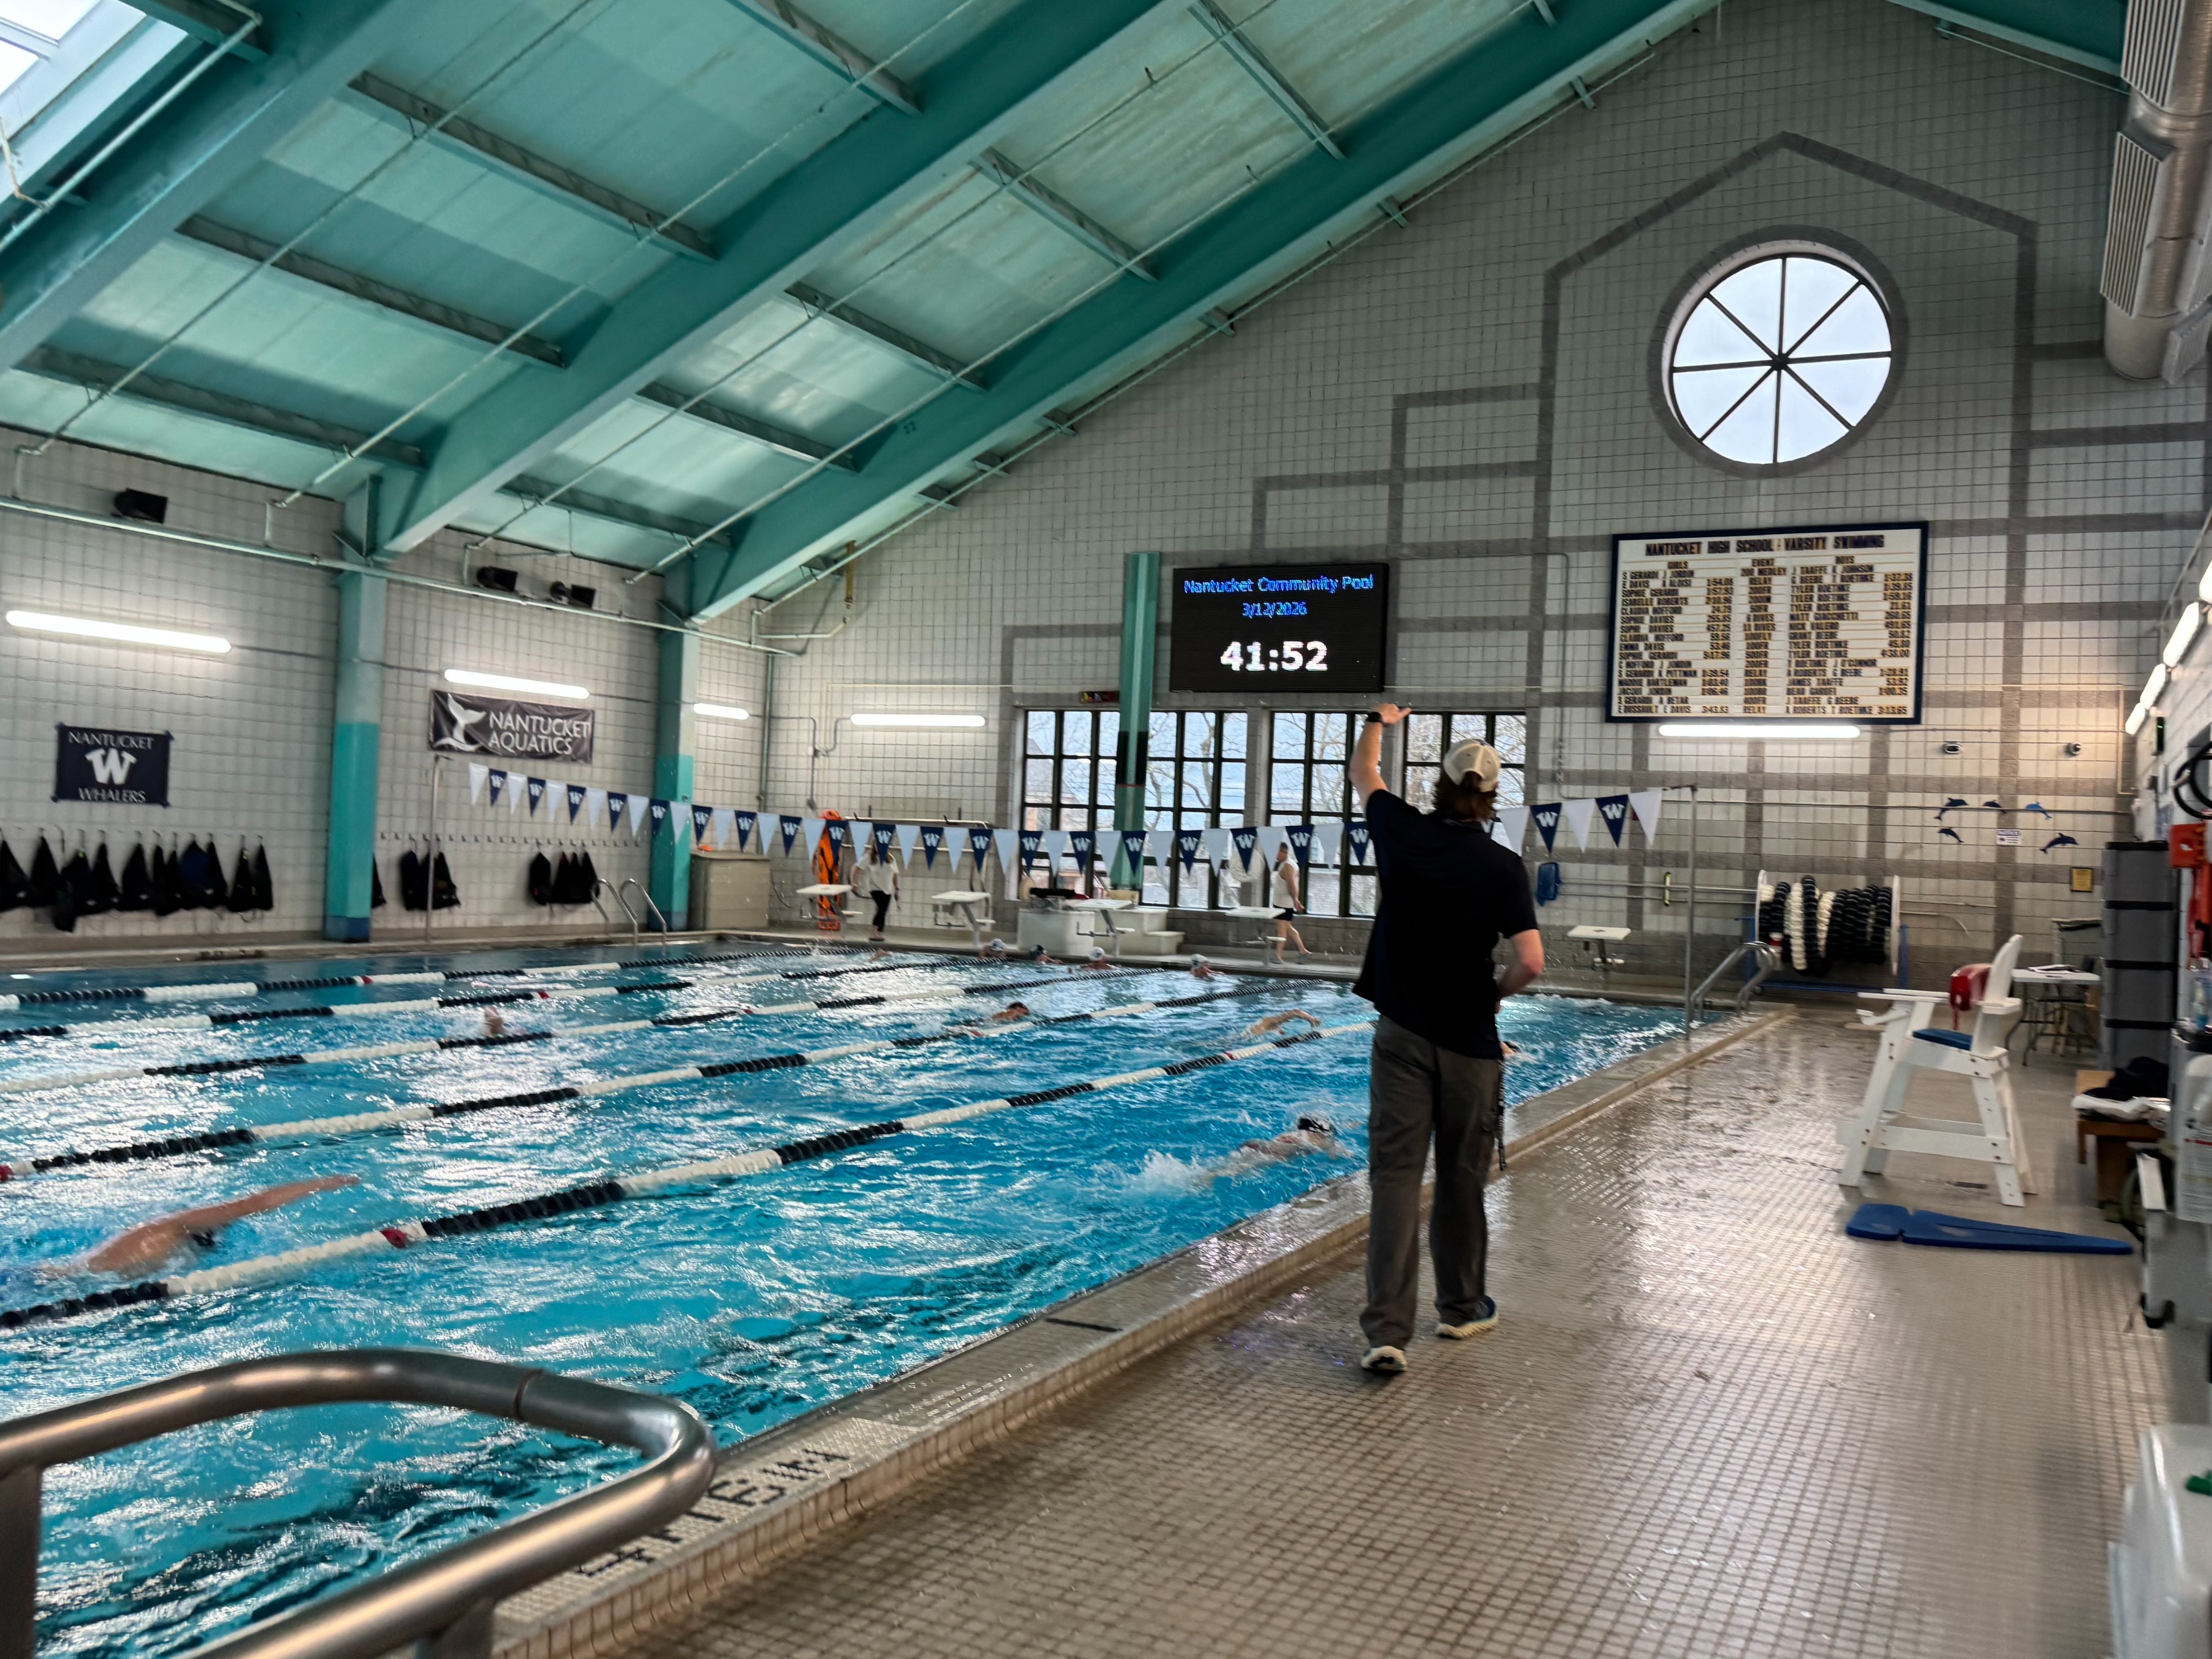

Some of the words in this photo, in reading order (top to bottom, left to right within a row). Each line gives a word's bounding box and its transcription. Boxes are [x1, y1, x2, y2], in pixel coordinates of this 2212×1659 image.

[1645, 542, 1702, 556] NANTUCKET
[1708, 541, 1730, 554] HIGH
[1737, 539, 1774, 552] SCHOOL
[1784, 537, 1827, 550] VARSITY
[1835, 535, 1884, 549] SWIMMING
[1184, 577, 1253, 594] Nantucket
[1257, 575, 1338, 594] Community
[1342, 574, 1373, 590] Pool
[1791, 584, 1814, 593] TYLER
[1242, 601, 1307, 618] 3/12/2026
[1791, 603, 1812, 612] TYLER
[1220, 641, 1328, 671] 41:52
[489, 711, 590, 738] NANTUCKET
[69, 731, 154, 750] NANTUCKET
[488, 730, 572, 754] AQUATICS
[85, 747, 137, 785] W
[78, 787, 146, 802] WHALERS
